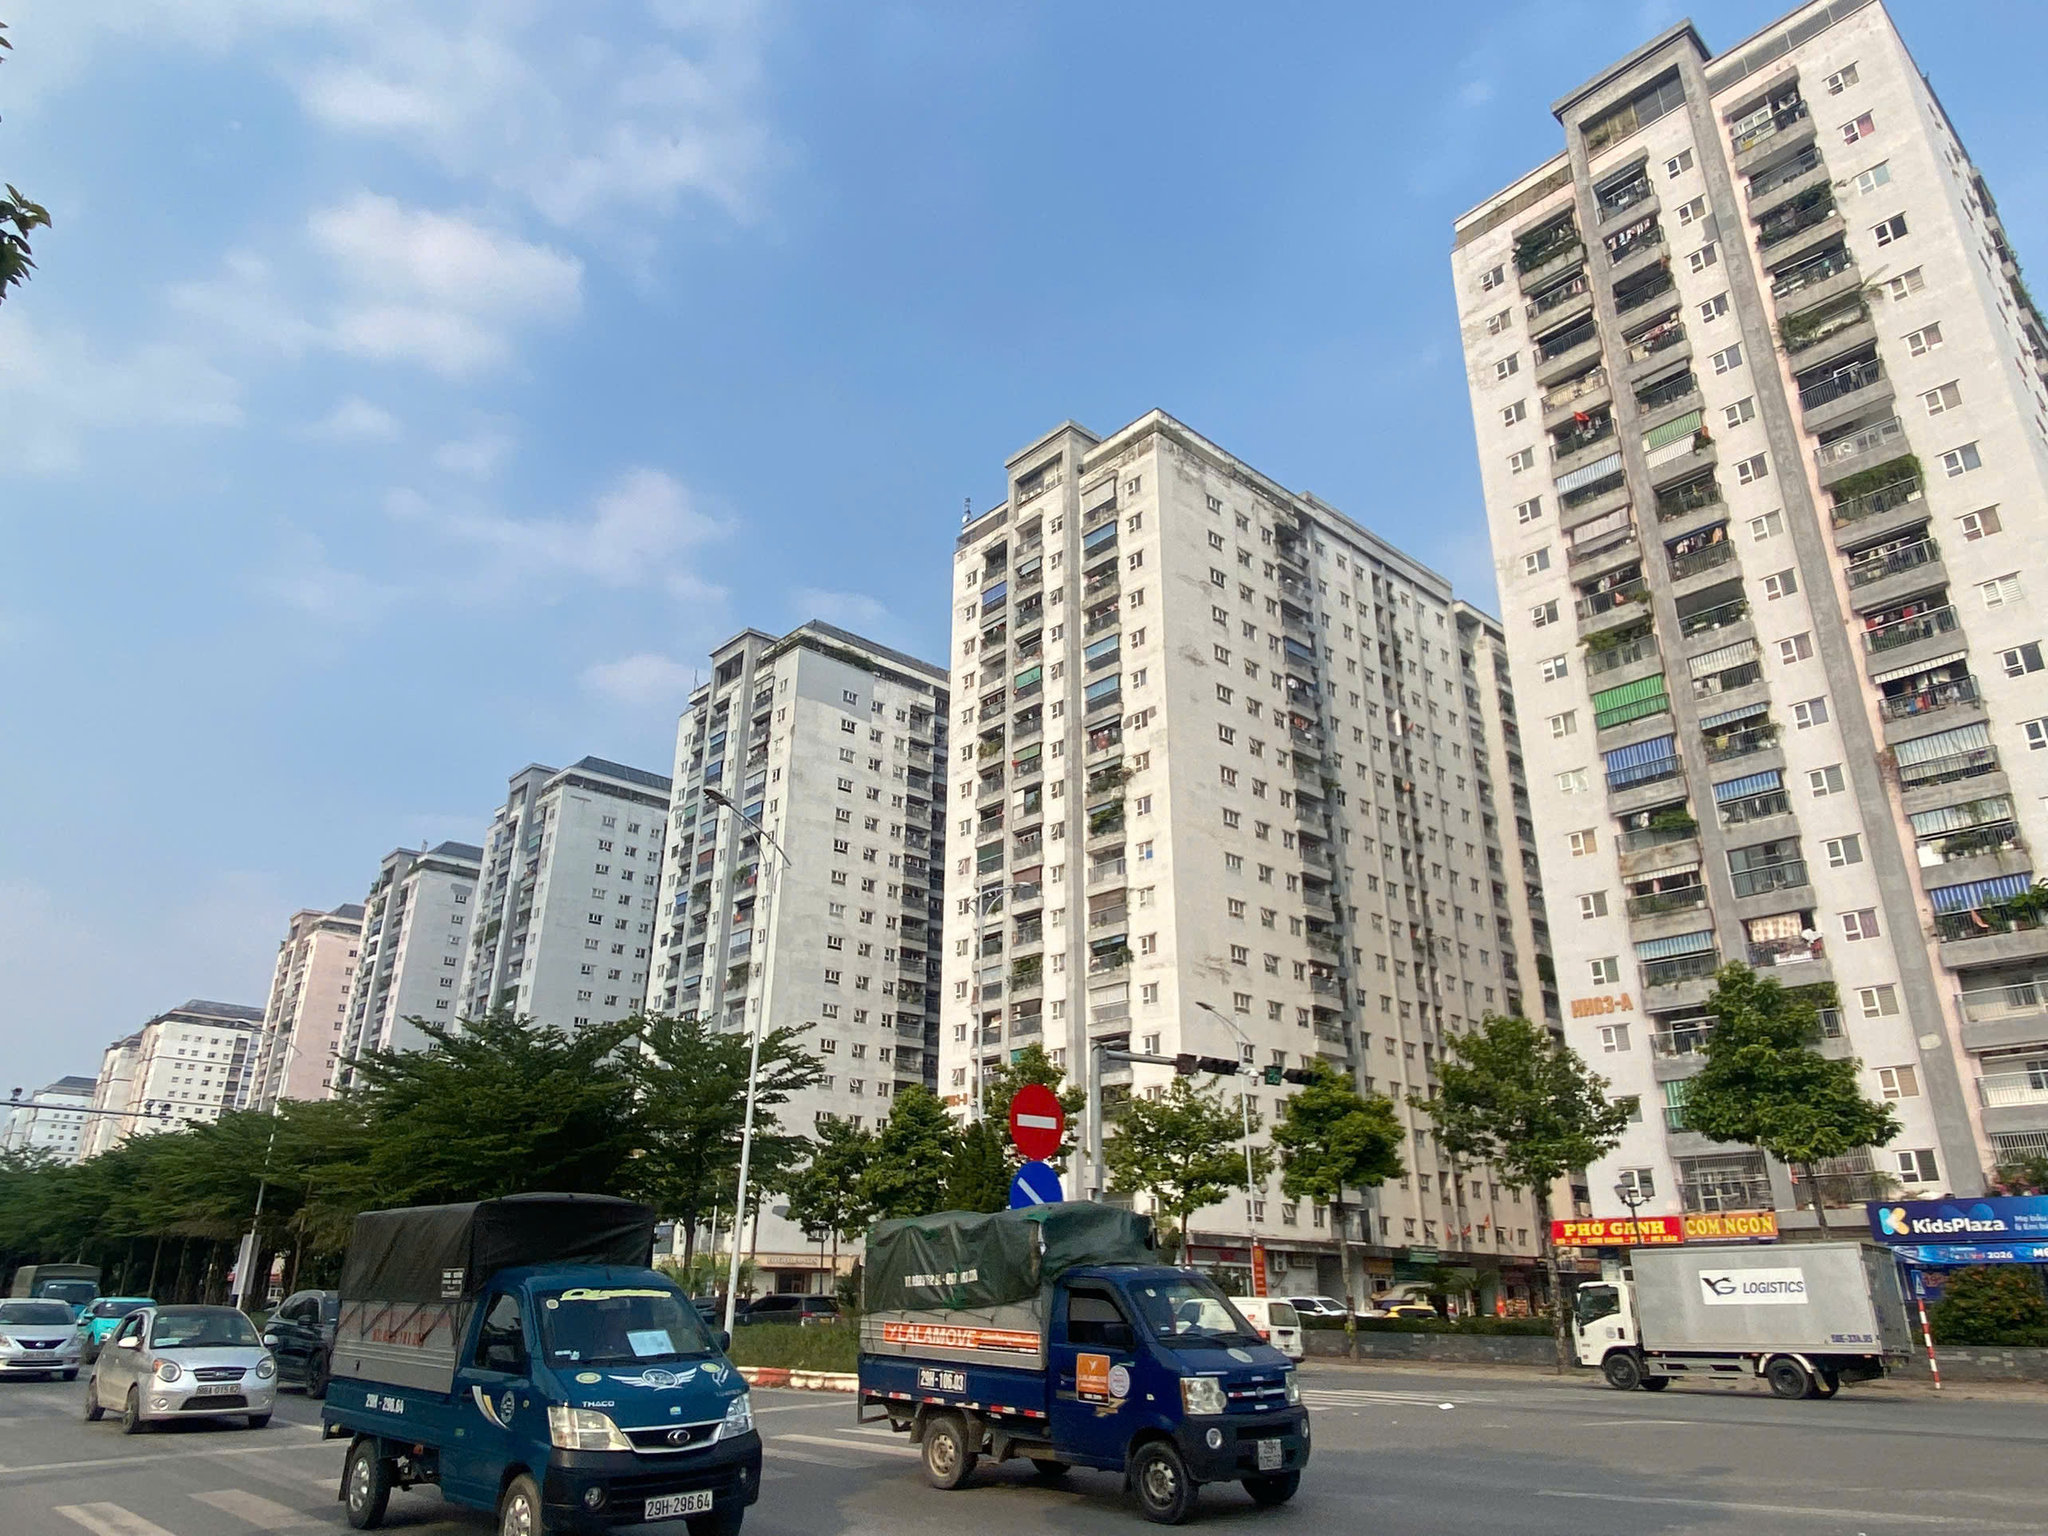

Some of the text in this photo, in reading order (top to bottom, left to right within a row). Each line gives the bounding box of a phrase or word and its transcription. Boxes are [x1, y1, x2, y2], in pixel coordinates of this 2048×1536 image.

[1724, 1215, 1774, 1234] NGON
[1912, 1218, 2006, 1234] KidsPlaza
[1987, 1251, 2014, 1259] 2026
[1743, 1281, 1804, 1294] LOGISTICS
[898, 1325, 979, 1347] LALAMOVE
[582, 1400, 615, 1408] THACO
[646, 1493, 711, 1517] 29H-296.64
